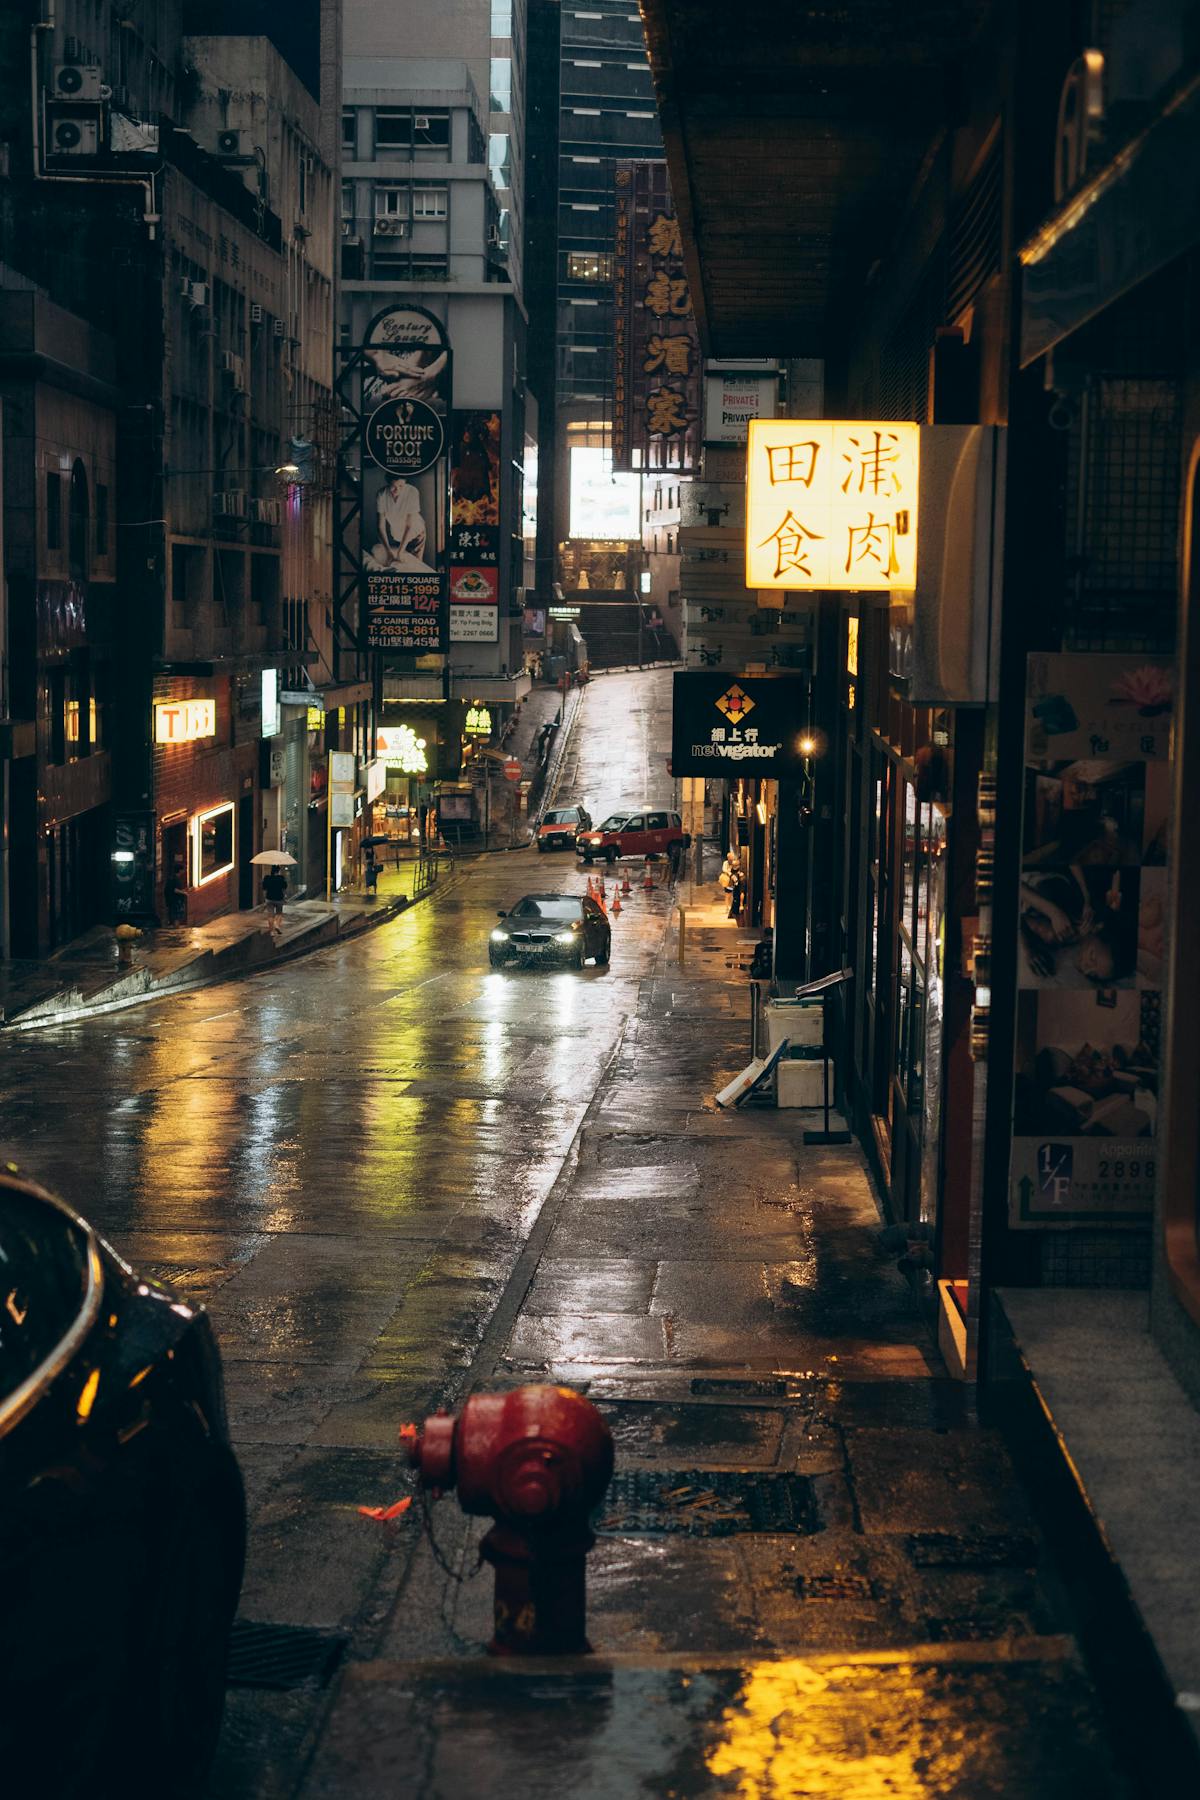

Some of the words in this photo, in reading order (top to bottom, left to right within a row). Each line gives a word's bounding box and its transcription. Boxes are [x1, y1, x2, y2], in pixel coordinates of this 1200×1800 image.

[381, 318, 433, 335] Century
[376, 425, 434, 441] FORTUNE
[386, 441, 422, 456] FOOT
[386, 456, 422, 465] massage
[367, 576, 405, 584] CENTURY
[406, 576, 440, 584] SQUARE
[368, 584, 378, 594] T:
[380, 585, 440, 594] 2115-1999
[368, 625, 378, 635] T:
[380, 626, 440, 635] 2633-8611
[711, 727, 759, 742] 網上行
